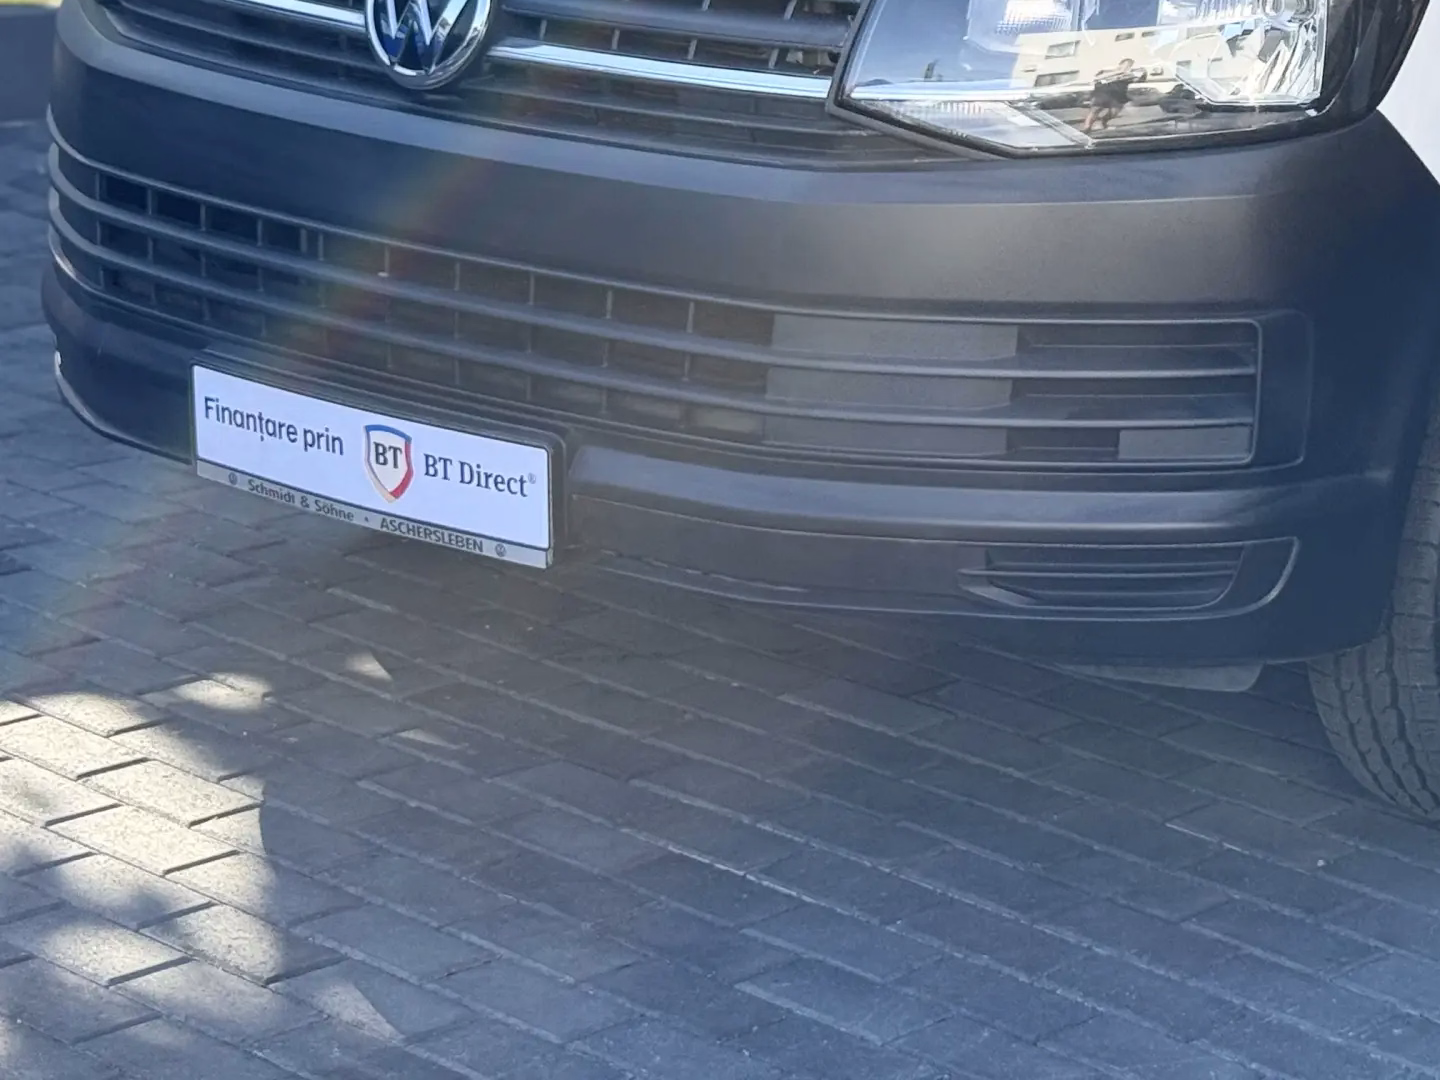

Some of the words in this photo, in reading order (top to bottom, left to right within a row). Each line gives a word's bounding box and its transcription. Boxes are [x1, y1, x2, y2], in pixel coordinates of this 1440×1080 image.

[204, 395, 299, 442] Finanțare
[303, 427, 344, 456] prin
[373, 441, 402, 469] BT
[423, 453, 452, 481] BT
[247, 478, 296, 504] Schmidt
[300, 495, 311, 509] &
[314, 499, 354, 522] Söhne
[379, 517, 484, 553] ASCHERSLEBEN
